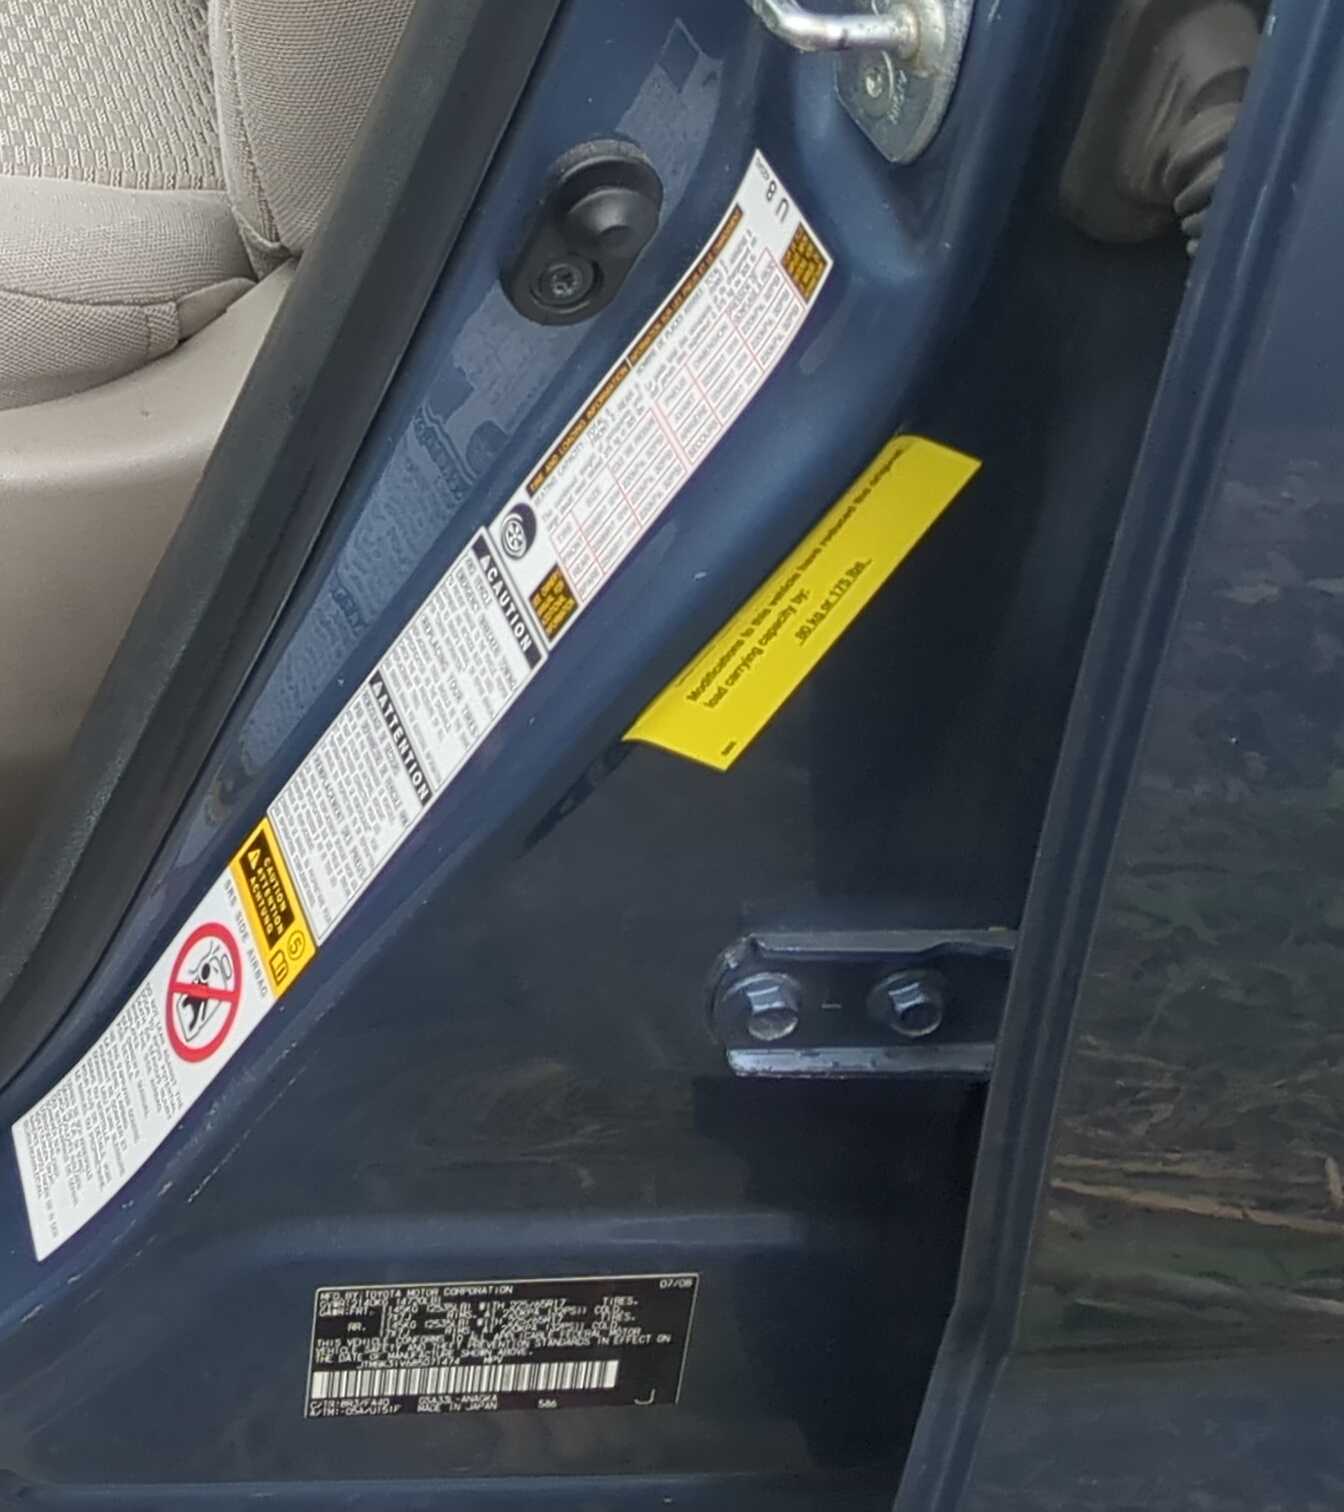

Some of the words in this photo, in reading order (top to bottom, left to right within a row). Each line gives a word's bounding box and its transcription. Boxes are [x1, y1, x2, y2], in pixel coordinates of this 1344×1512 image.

[486, 564, 532, 653] CAUTION
[684, 637, 747, 702] Modifications
[749, 607, 772, 626] this
[766, 571, 802, 606] vehicle
[795, 546, 823, 571] have
[817, 504, 857, 546] reduced
[851, 486, 872, 504] the
[804, 610, 826, 625] kg
[818, 598, 834, 611] or
[827, 577, 852, 598] 175
[702, 685, 729, 708] load
[720, 645, 764, 687] carrying
[753, 603, 799, 647] capacity
[377, 690, 429, 801] ATTENTION
[224, 876, 237, 908] SRS
[234, 908, 249, 944] SIDE
[246, 944, 268, 1000] AIRBAG
[249, 872, 273, 936] ACHTUNG
[255, 864, 284, 936] ATTENTION
[263, 854, 286, 915] CAUTION
[289, 933, 302, 958] 5
[406, 1288, 439, 1297] MOTOR
[443, 1286, 513, 1296] CORPORATION
[659, 1278, 692, 1288] 07/08
[656, 1334, 672, 1343] ON
[466, 1399, 498, 1411] JAPAN
